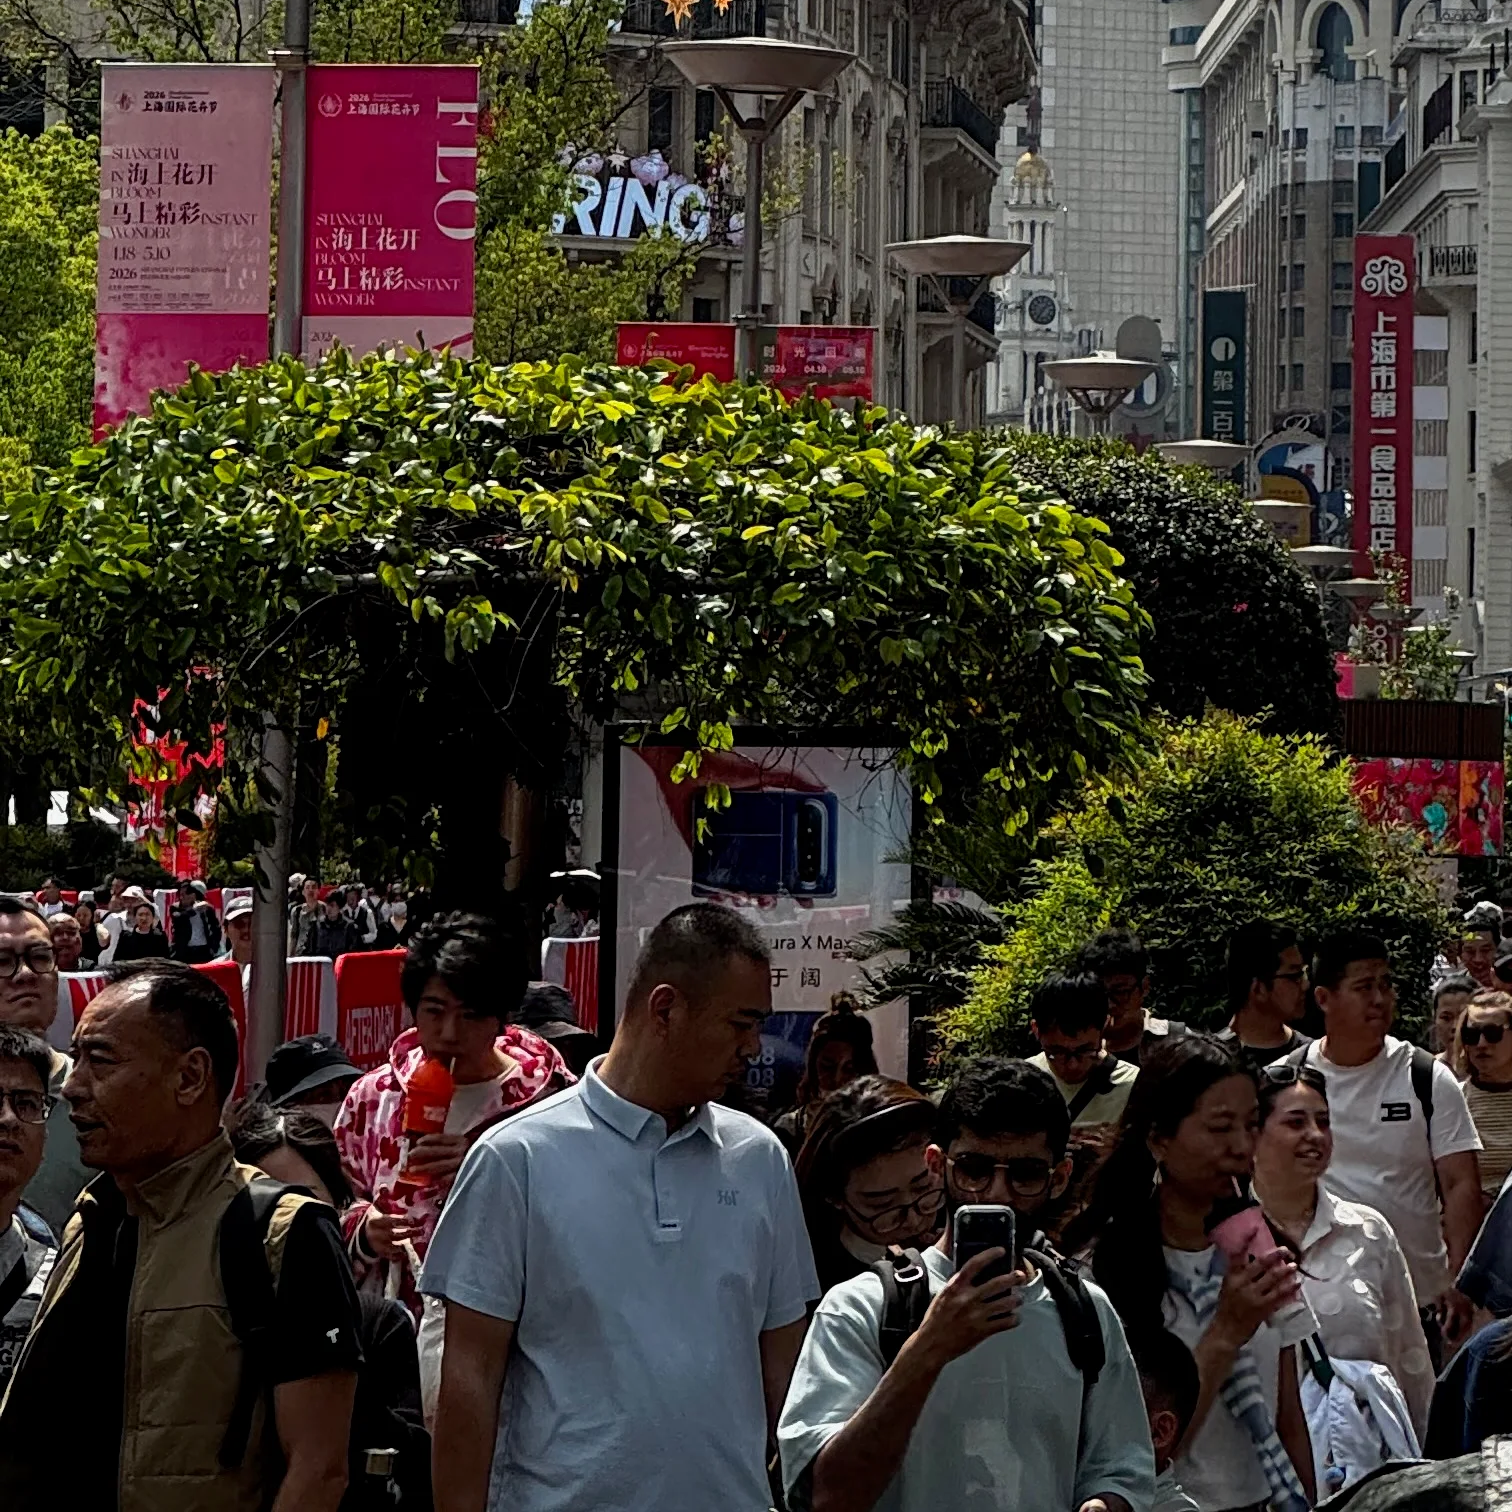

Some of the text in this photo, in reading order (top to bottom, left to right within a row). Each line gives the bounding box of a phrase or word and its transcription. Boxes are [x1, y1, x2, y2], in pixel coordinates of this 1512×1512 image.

[143, 90, 166, 99] 2026
[347, 93, 370, 102] 2026
[141, 100, 218, 114] 上海国际花卉节
[346, 103, 421, 116] 上海国际花卉节
[111, 147, 179, 160] SHANGHAI
[111, 162, 220, 185] IN 海上花开
[110, 187, 162, 199] BLOOM
[111, 201, 201, 225] 马上精彩
[315, 212, 384, 226] SHANGHAI
[110, 226, 172, 239] WONDER
[315, 227, 421, 251] IN 海上花开
[315, 253, 366, 265] BLOOM
[109, 267, 138, 280] 2026
[316, 267, 404, 291] 马上精彩
[314, 292, 375, 306] WONDER
[763, 364, 787, 374] 2026
[1369, 310, 1398, 554] 上海市第一食品商店
[801, 936, 813, 950] X
